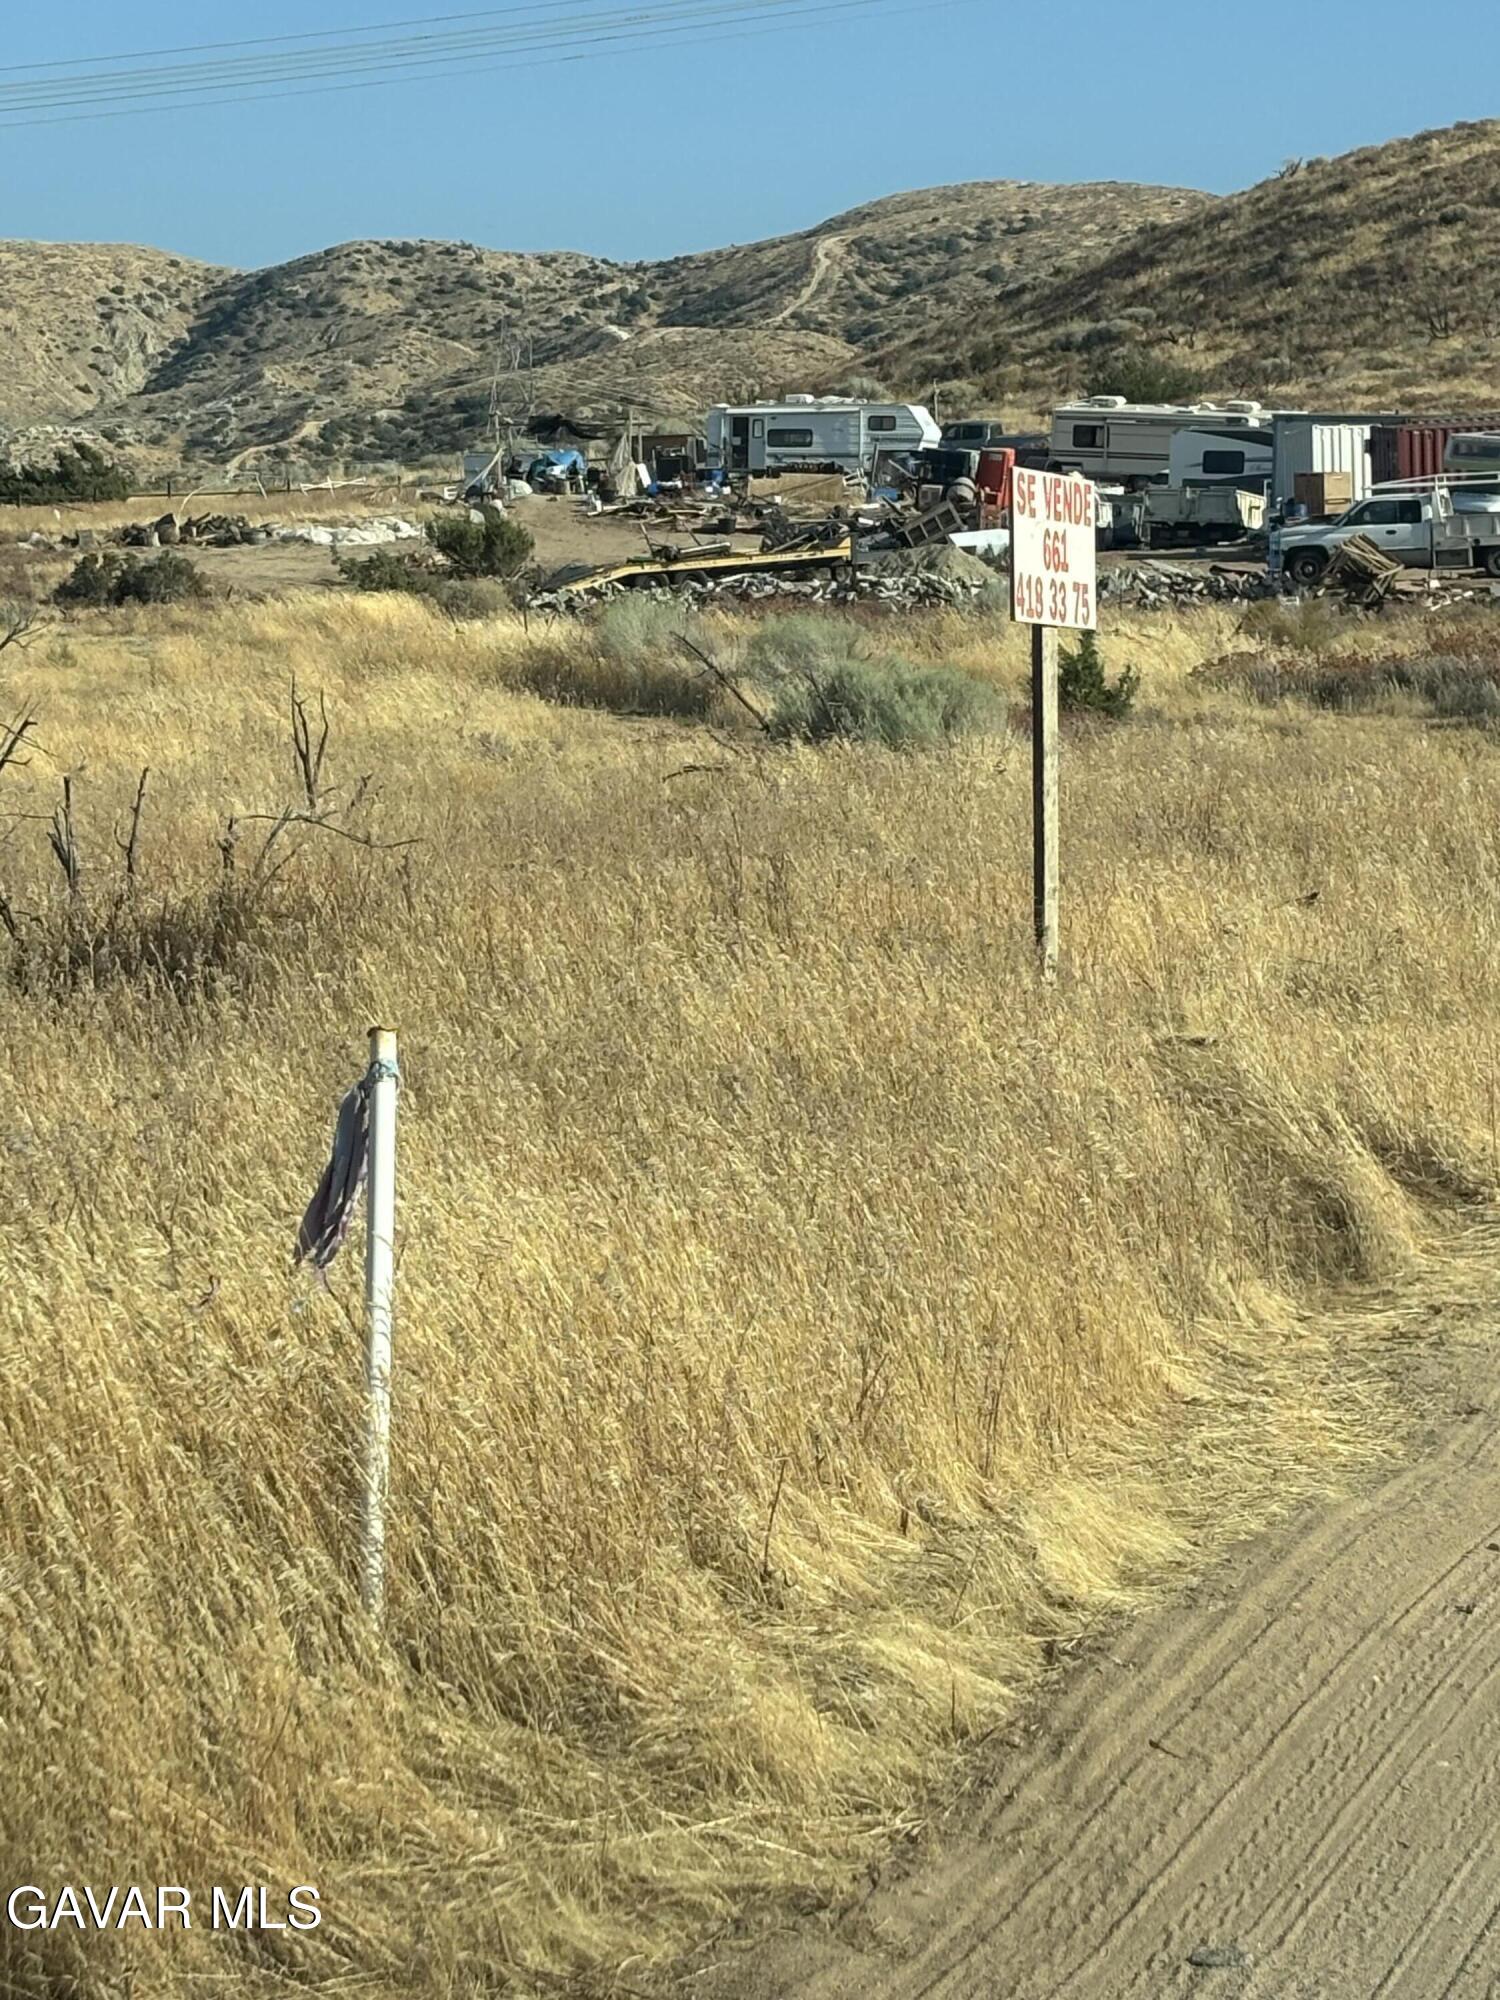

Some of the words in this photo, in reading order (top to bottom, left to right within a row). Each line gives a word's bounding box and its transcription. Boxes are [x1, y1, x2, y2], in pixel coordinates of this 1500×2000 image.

[1017, 471, 1036, 519] SE
[1043, 475, 1092, 527] VENDE
[1043, 528, 1069, 573] 661
[1016, 572, 1043, 620] 418
[1049, 578, 1067, 623] 33
[1072, 581, 1090, 626] 75
